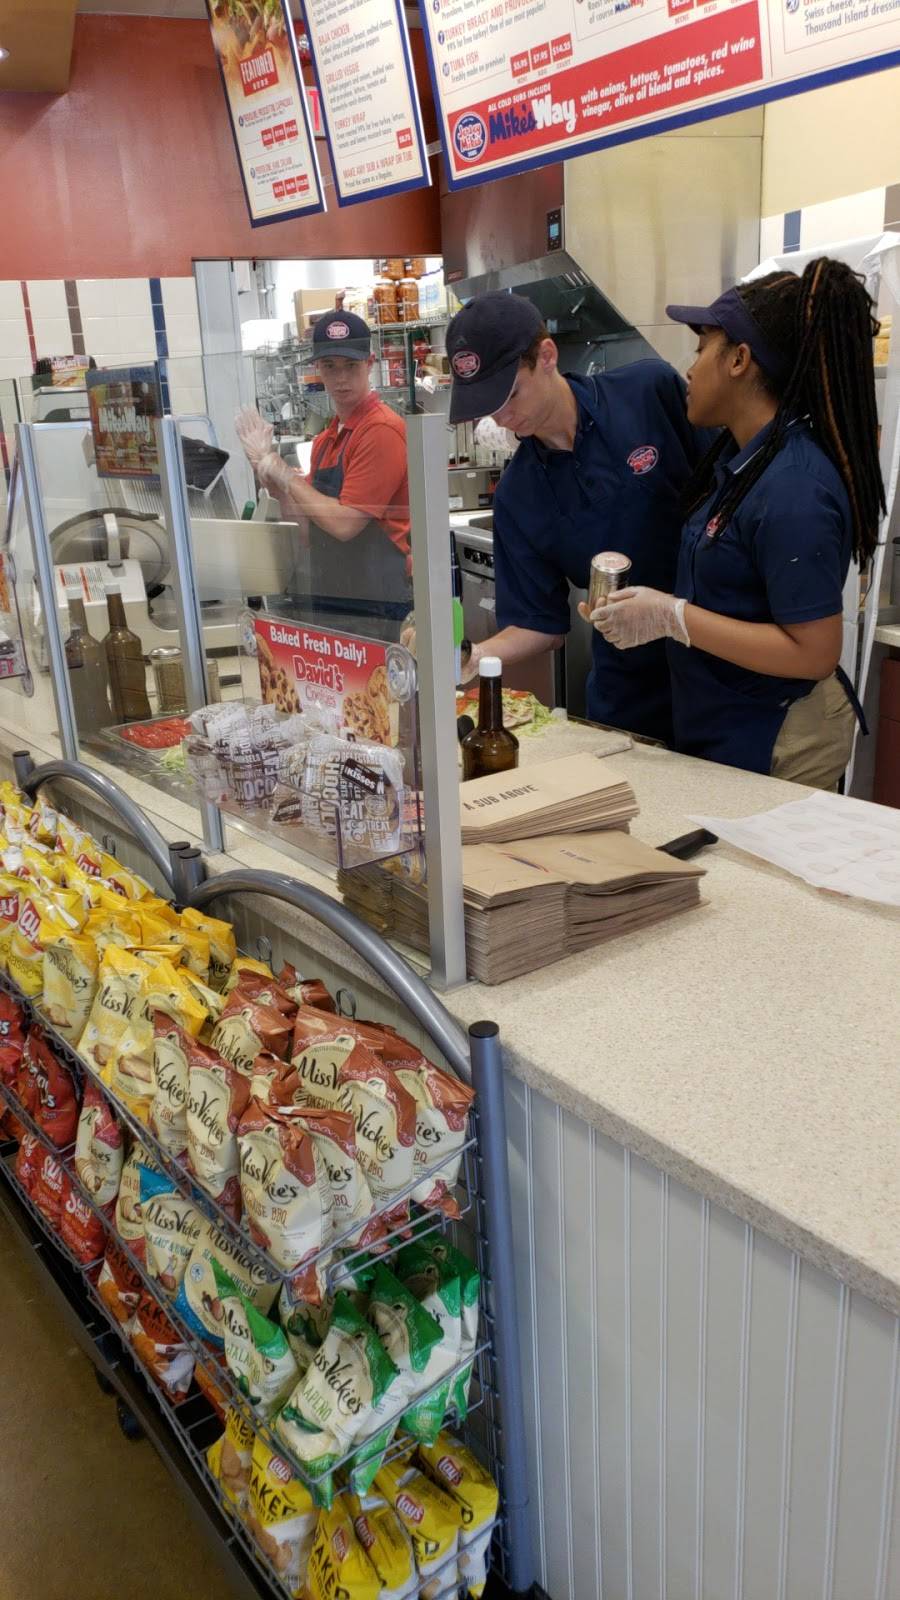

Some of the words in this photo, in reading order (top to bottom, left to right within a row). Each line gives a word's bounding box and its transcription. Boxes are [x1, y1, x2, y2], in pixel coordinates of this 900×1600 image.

[445, 22, 465, 40] TURKEY
[466, 11, 489, 32] BREAST
[490, 5, 504, 20] AND
[804, 15, 842, 36] Thousand
[844, 6, 869, 24] Island
[805, 9, 825, 22] Swiss
[826, 0, 856, 14] cheese,
[240, 51, 275, 84] FEATURED
[449, 56, 465, 71] TUNA
[466, 50, 479, 64] FISH
[581, 86, 599, 104] with
[599, 81, 628, 98] onions,
[630, 70, 661, 89] lettuce,
[664, 53, 709, 76] tomatoes,
[711, 41, 728, 62] red
[731, 36, 756, 55] wine
[488, 103, 498, 113] ALL
[497, 97, 512, 109] COLD
[512, 91, 527, 104] SUBS
[527, 82, 551, 98] INCLUDE
[582, 99, 613, 118] vinegar,
[614, 92, 634, 108] olive
[636, 86, 647, 101] oil
[648, 78, 673, 97] blend
[674, 70, 692, 89] and
[693, 63, 725, 84] spices.
[488, 103, 537, 144] Mike's
[531, 93, 577, 133] Way
[270, 625, 301, 649] Baked
[303, 632, 331, 656] Fresh
[334, 639, 368, 668] Daily!
[292, 654, 345, 694] David's
[463, 802, 474, 811] A
[473, 795, 500, 808] SUB
[499, 784, 539, 801] ABOVE
[298, 1055, 331, 1088] Miss
[197, 1090, 225, 1147] Vickie's
[355, 1103, 396, 1163] Vickie's
[325, 1353, 363, 1416] Vickie's
[397, 1495, 422, 1520] Lay's
